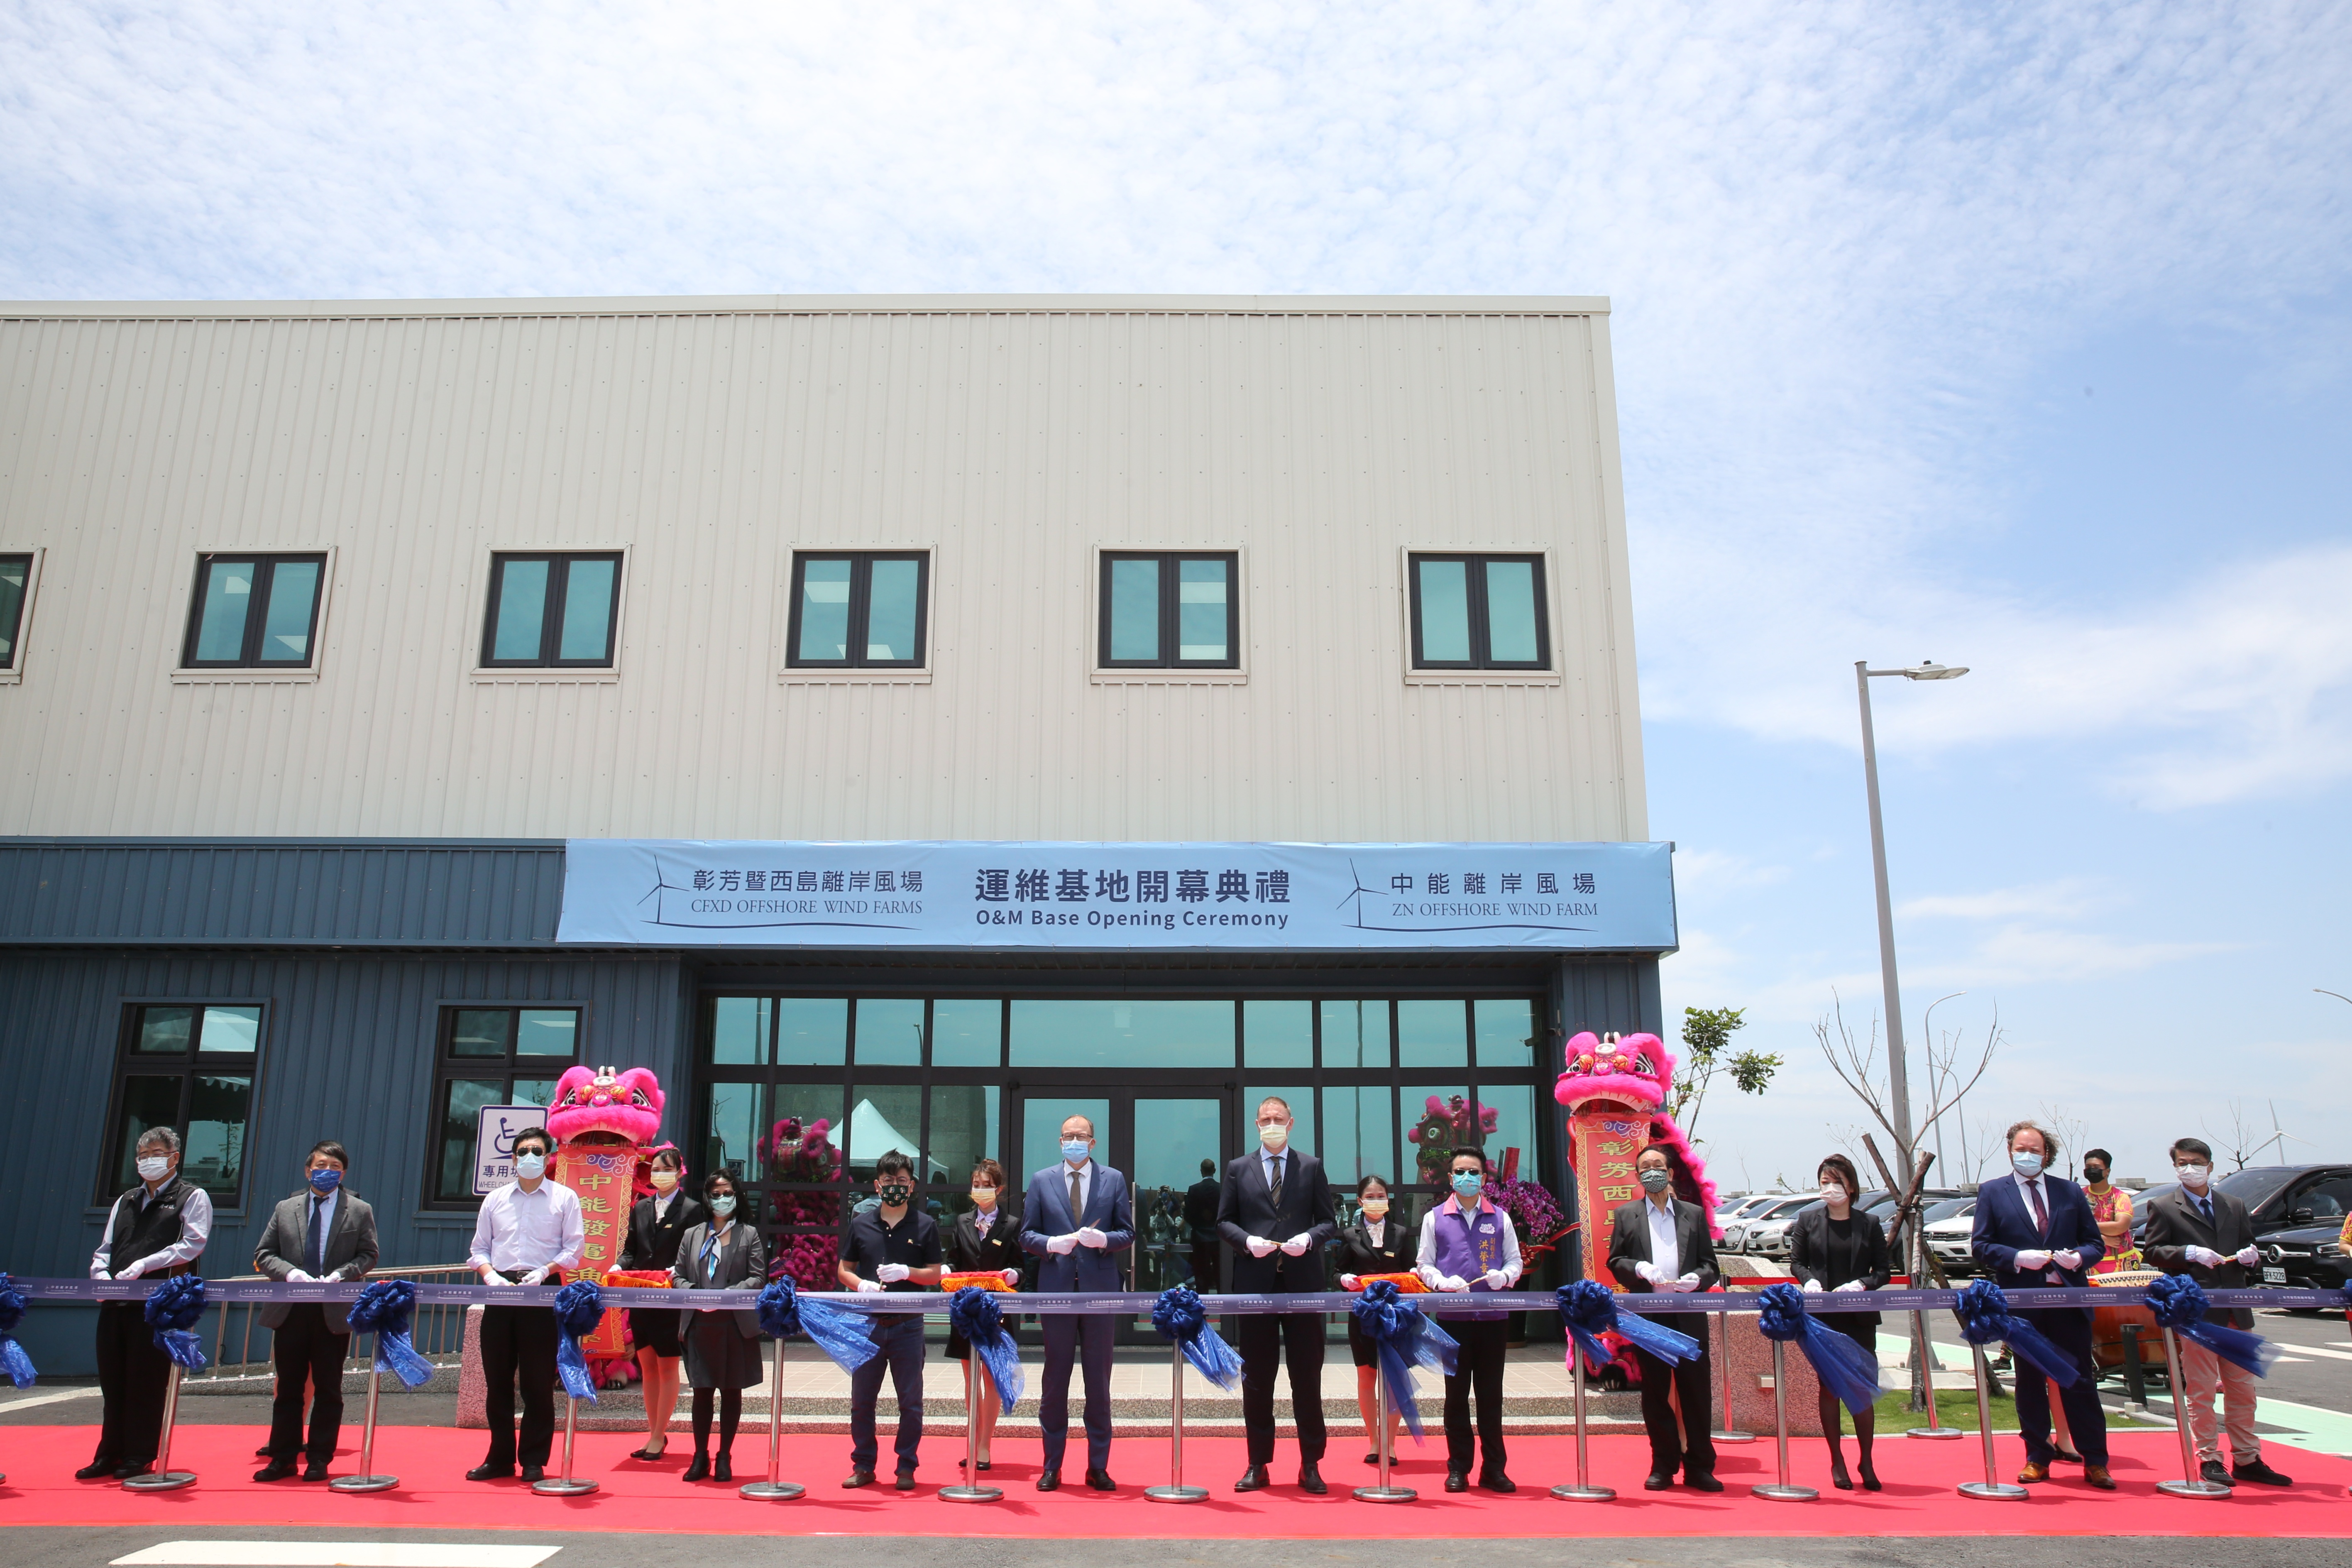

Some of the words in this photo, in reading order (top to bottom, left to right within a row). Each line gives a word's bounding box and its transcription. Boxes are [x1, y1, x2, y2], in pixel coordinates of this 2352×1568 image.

[693, 869, 922, 892] 彰芳暨西島離岸風場
[975, 868, 1290, 903] 運維基地開幕典禮
[1391, 873, 1595, 894] 中能離岸風場
[691, 900, 731, 912] CFXD
[737, 900, 817, 913] OFFSHORE
[824, 900, 868, 913] WIND
[873, 900, 922, 914] FARMS
[1393, 903, 1413, 916] ZN
[1420, 903, 1501, 916] OFFSHORE
[1507, 903, 1551, 915] WIND
[1557, 903, 1597, 915] FARM
[976, 910, 1022, 925] O&M
[1032, 910, 1079, 925] Base
[1088, 910, 1175, 930] Opening
[1183, 911, 1288, 930] Ceremony
